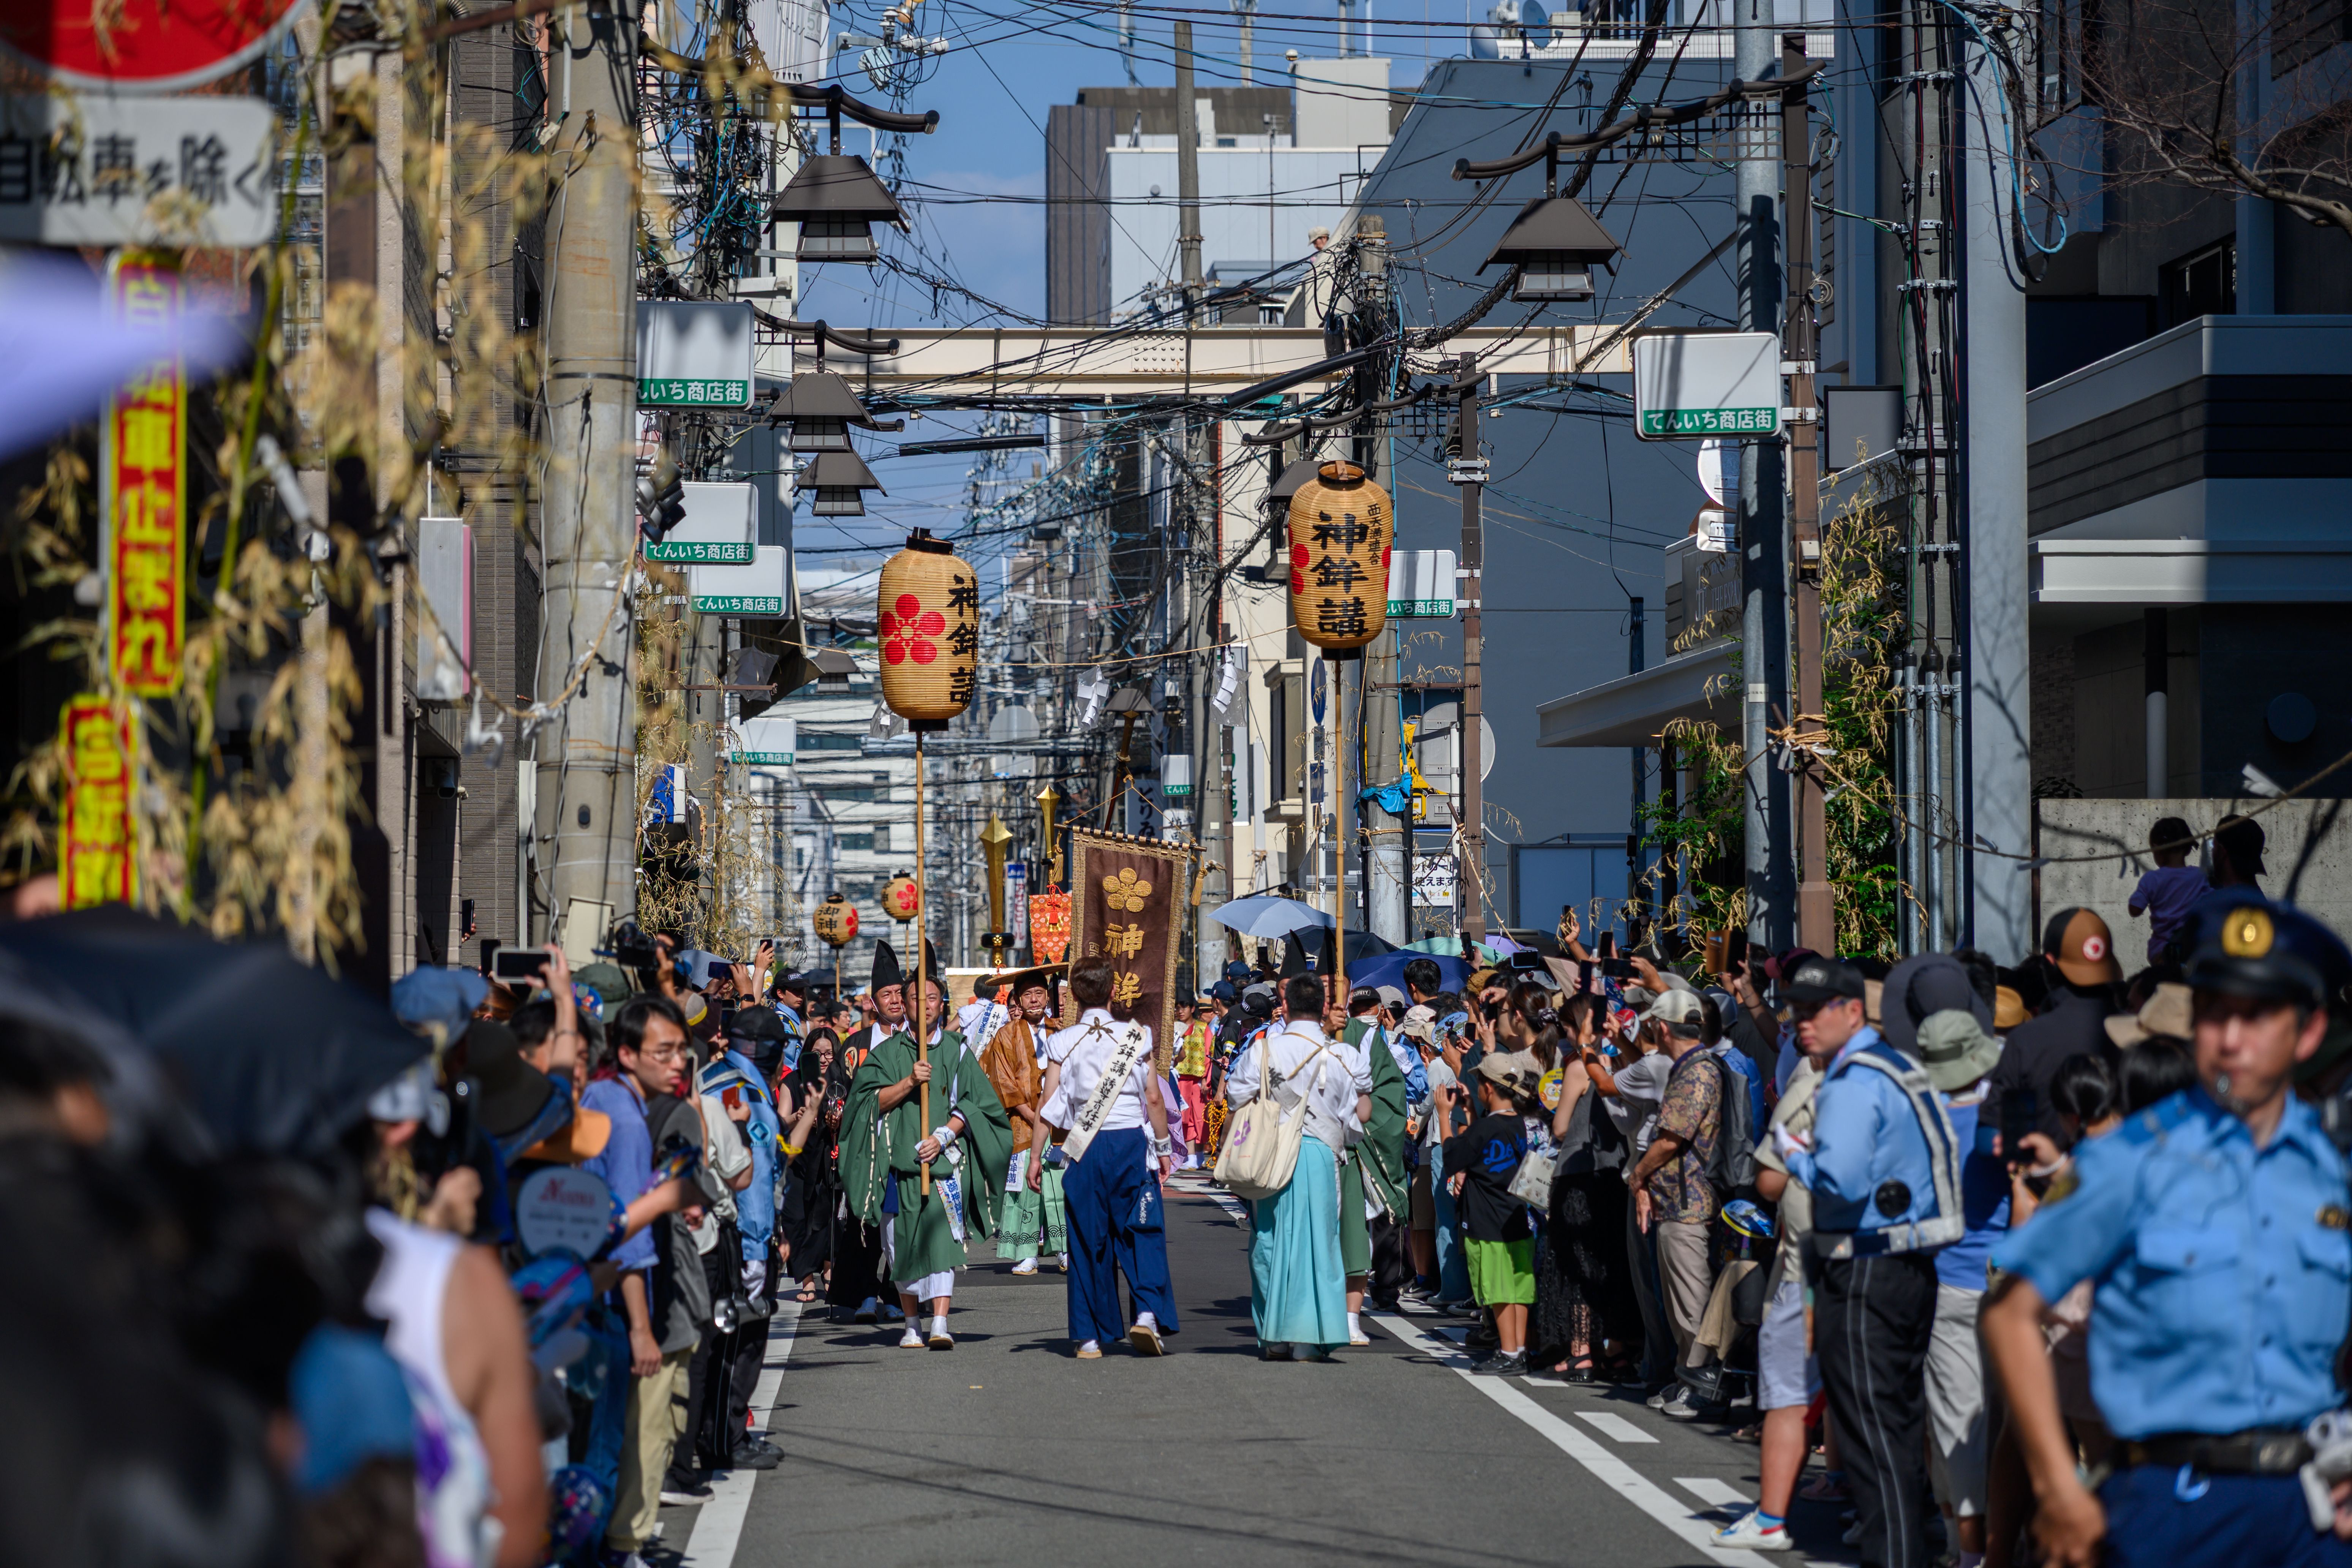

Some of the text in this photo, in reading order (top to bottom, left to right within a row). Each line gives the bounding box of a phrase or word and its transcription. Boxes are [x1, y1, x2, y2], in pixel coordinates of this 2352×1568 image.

[1647, 410, 1772, 430] てんいち商店街
[649, 543, 750, 560] てんいち商店街
[693, 596, 779, 611] てんいち商店街
[733, 752, 791, 763] てんいち商店街
[1165, 786, 1193, 794] てんいち
